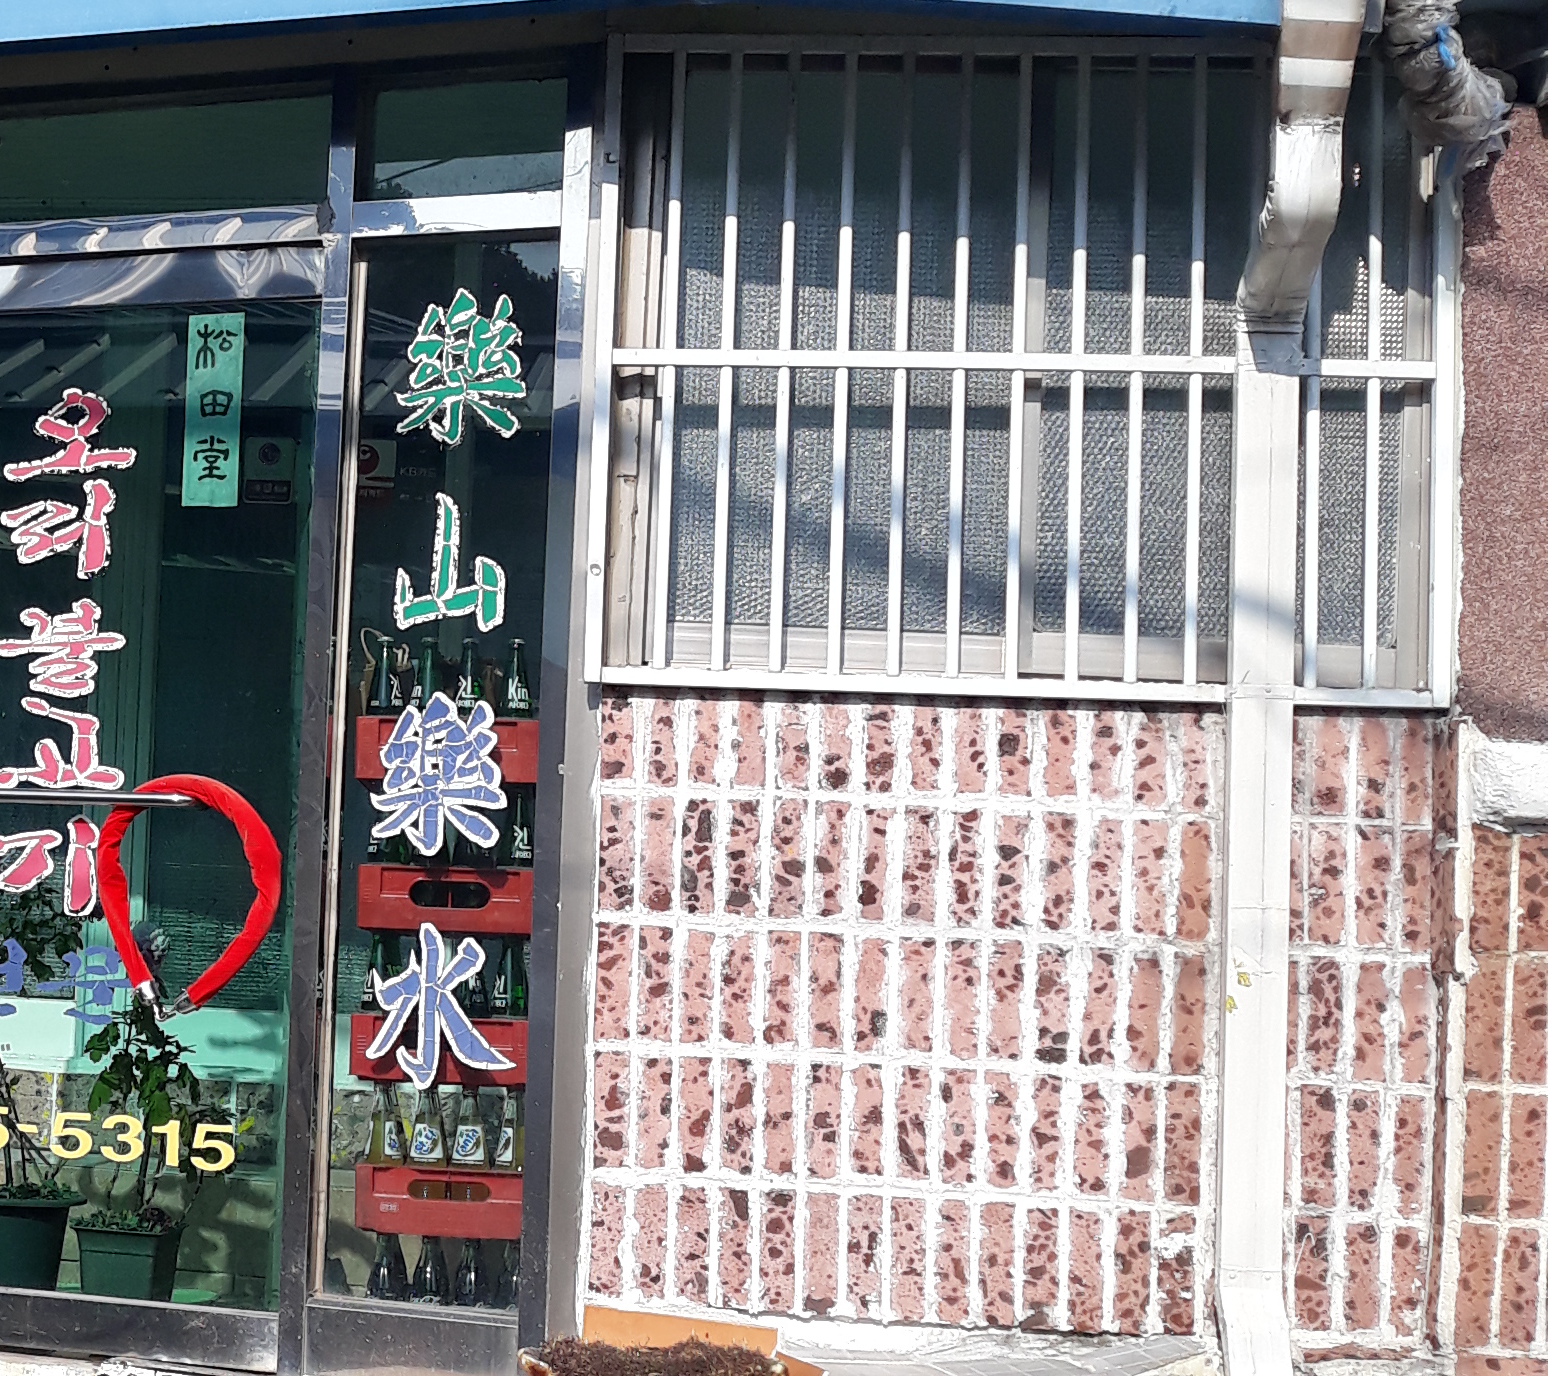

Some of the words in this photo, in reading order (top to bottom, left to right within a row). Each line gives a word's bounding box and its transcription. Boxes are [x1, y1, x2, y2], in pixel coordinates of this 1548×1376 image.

[365, 286, 528, 1090] 樂山樂水
[507, 675, 529, 700] Kin
